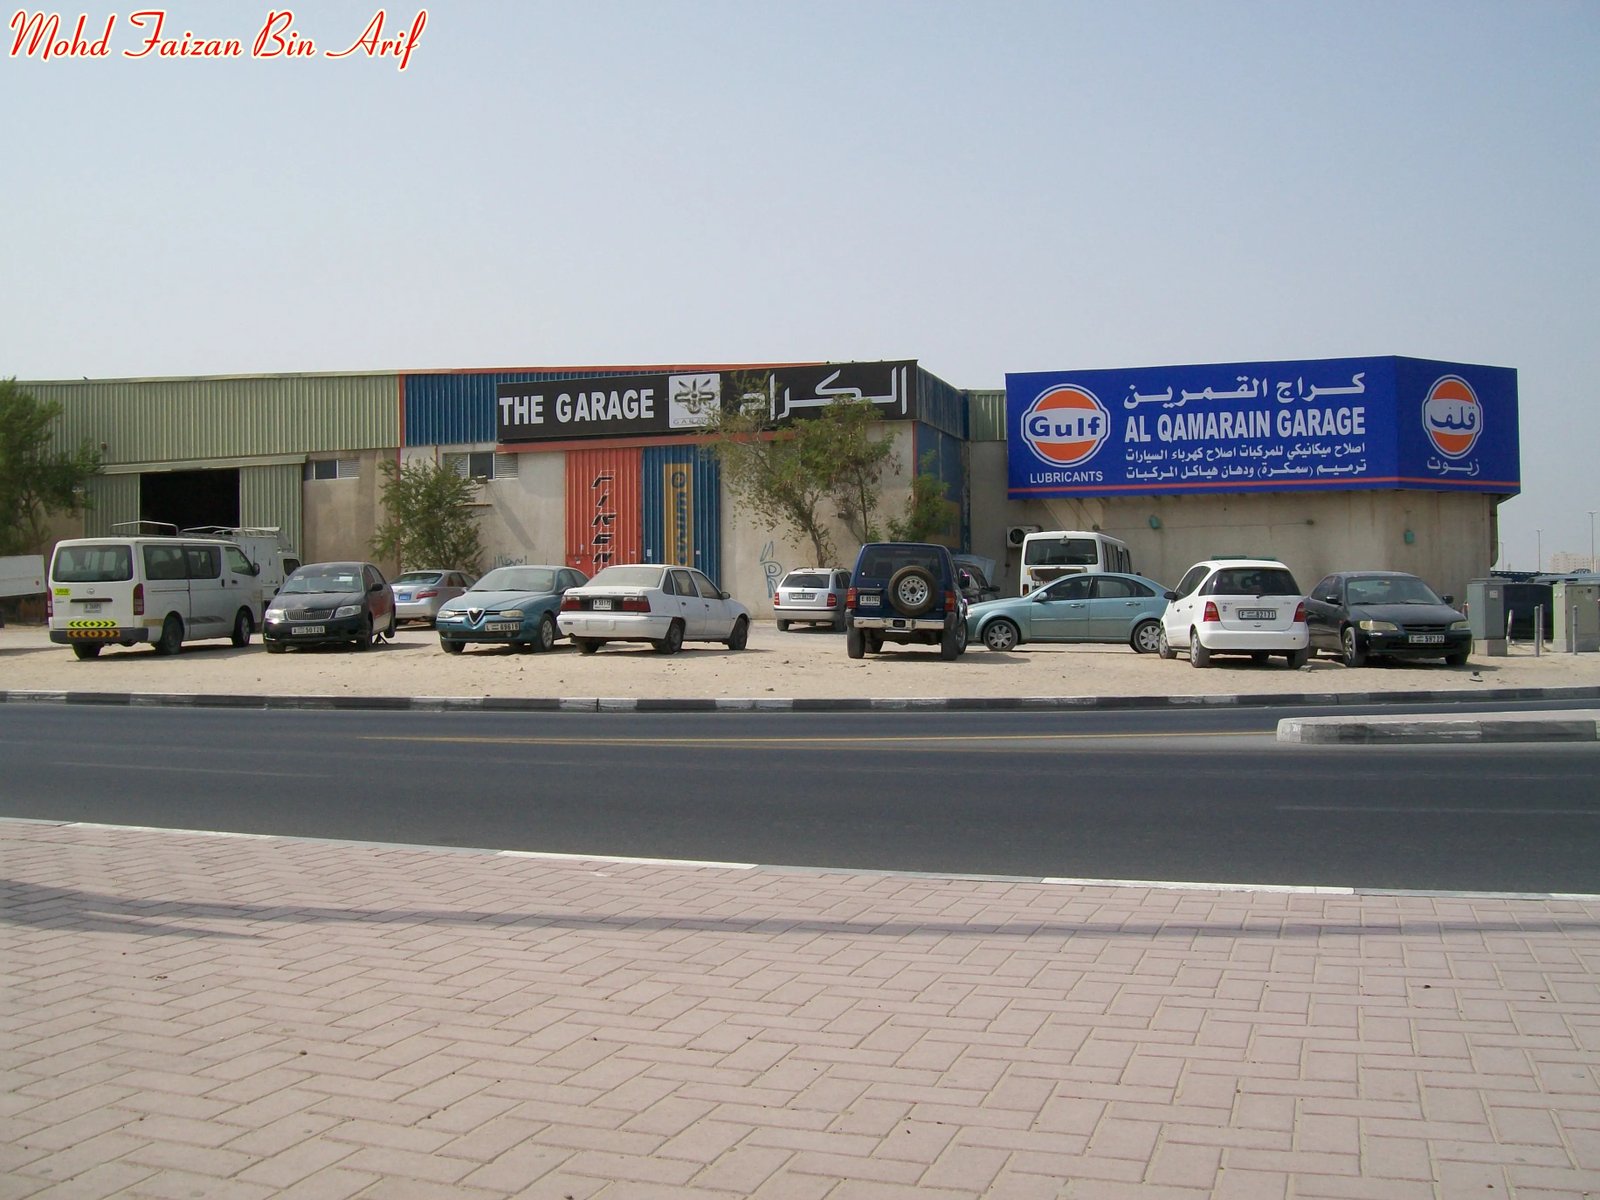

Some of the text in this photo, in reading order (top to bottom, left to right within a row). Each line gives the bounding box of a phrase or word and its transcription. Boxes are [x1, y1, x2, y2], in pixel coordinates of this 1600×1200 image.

[499, 387, 655, 427] THE GARAGE
[1124, 372, 1366, 410] كراج القمرين
[1028, 416, 1101, 438] Gulf
[1124, 406, 1366, 444] AL QAMARAIN GARAGE
[1030, 470, 1104, 485] LUBRICANTS
